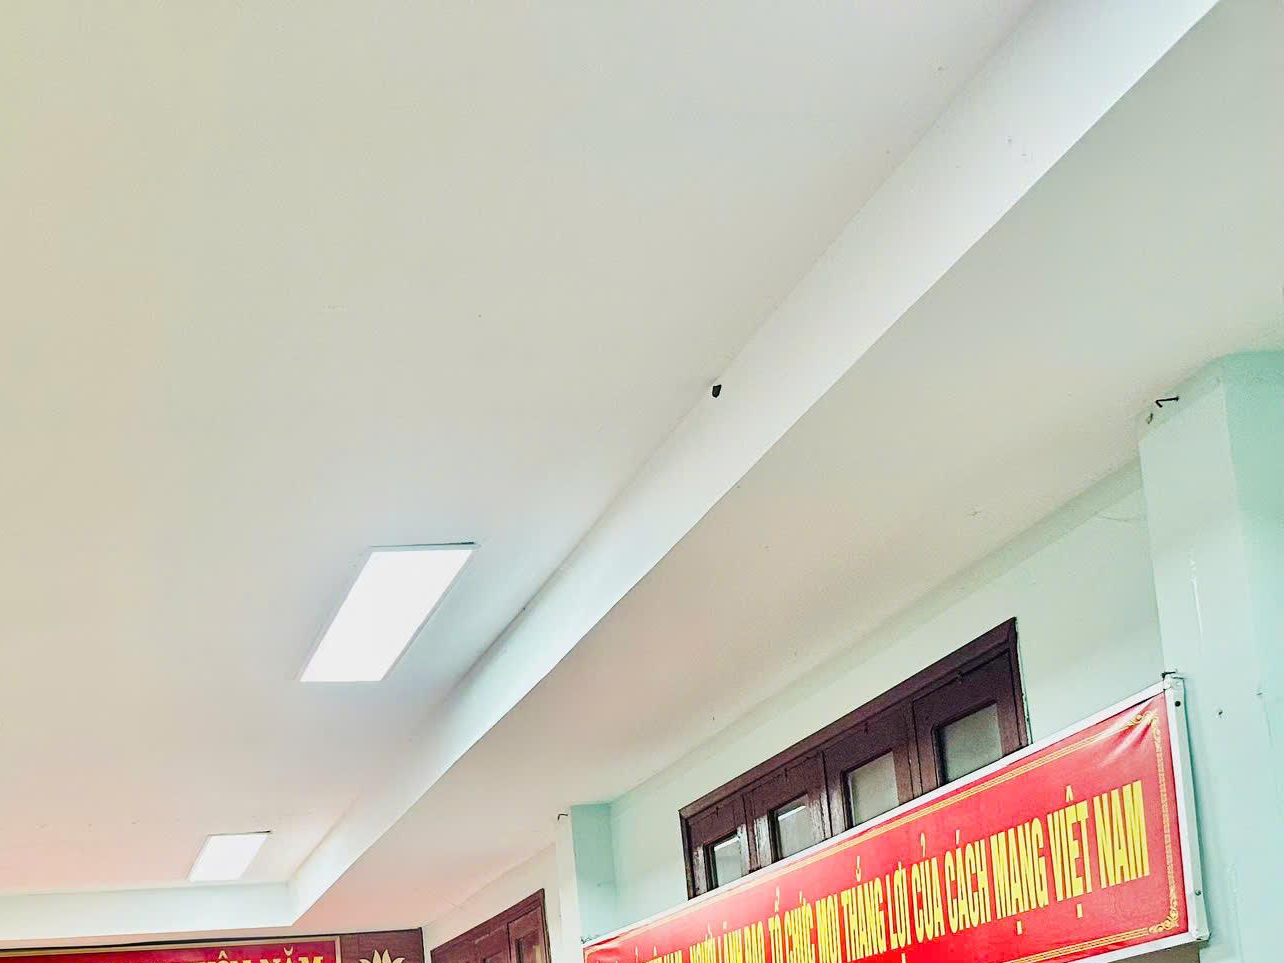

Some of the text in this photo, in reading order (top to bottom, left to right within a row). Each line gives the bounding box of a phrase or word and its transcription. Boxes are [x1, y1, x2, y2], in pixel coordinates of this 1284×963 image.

[841, 856, 887, 963] THẮNG
[911, 832, 946, 944] CỦA
[944, 829, 992, 934] CÁCH
[990, 817, 1049, 935] MẠNG
[1047, 785, 1093, 919] VIỆT
[1093, 780, 1150, 889] NAM
